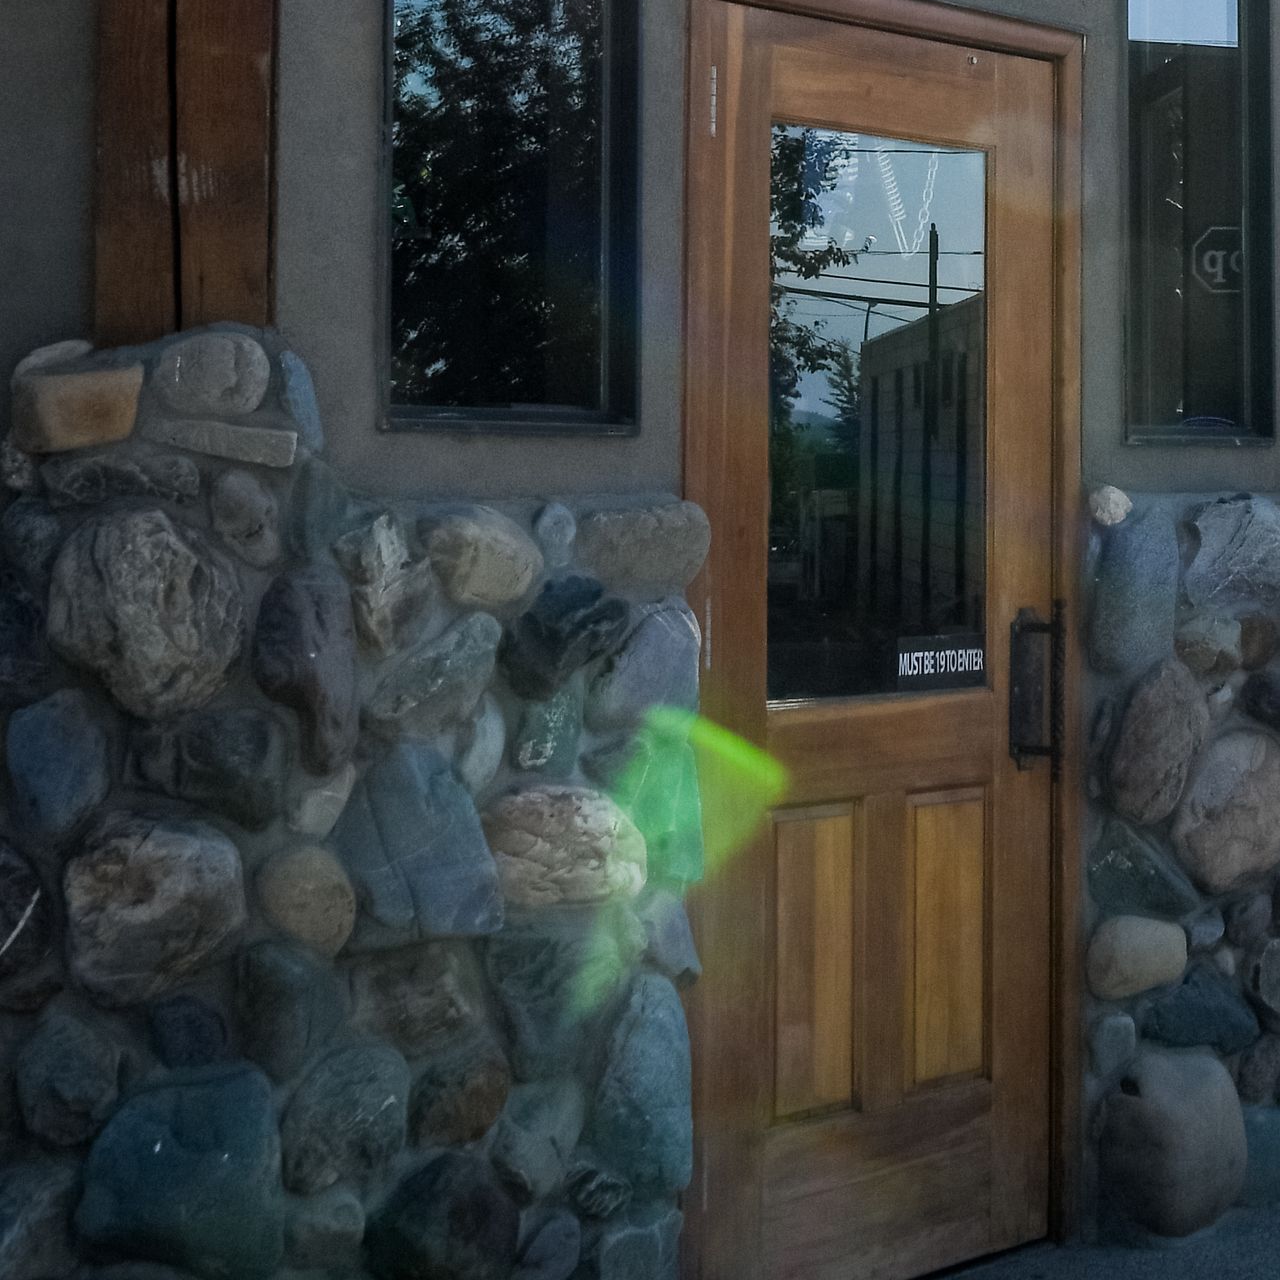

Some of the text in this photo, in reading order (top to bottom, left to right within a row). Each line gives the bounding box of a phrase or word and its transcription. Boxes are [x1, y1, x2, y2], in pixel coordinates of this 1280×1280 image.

[899, 649, 984, 676] MUST BE 19 TO ENTER
